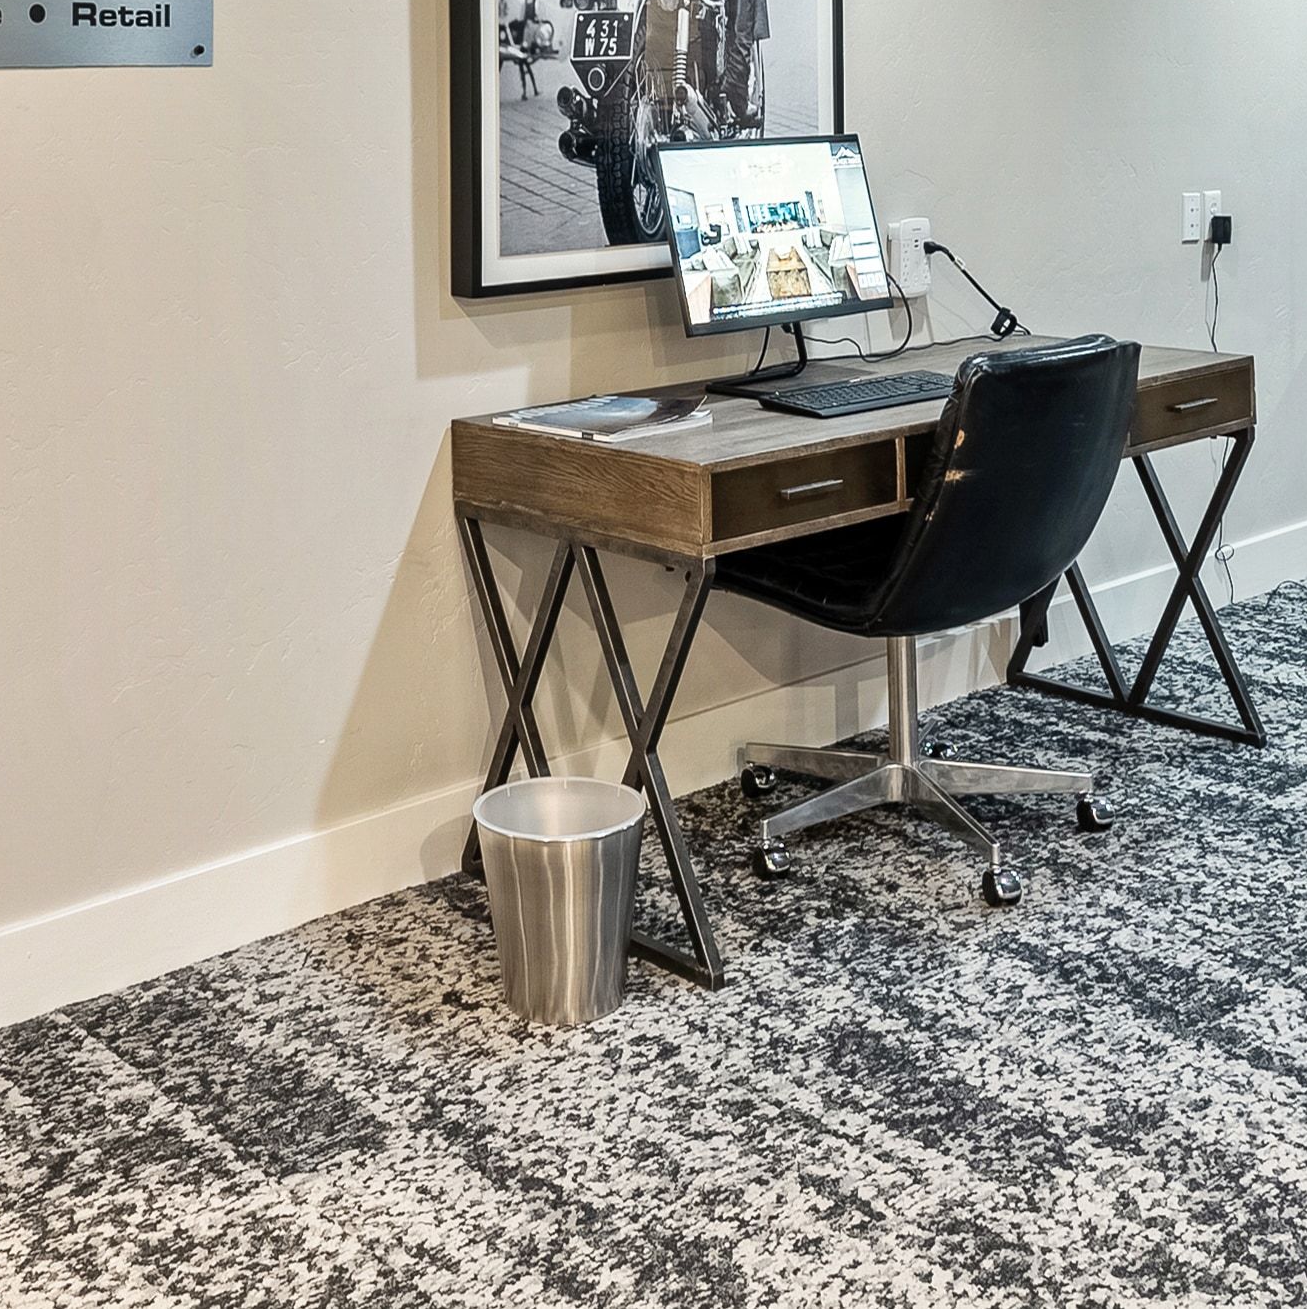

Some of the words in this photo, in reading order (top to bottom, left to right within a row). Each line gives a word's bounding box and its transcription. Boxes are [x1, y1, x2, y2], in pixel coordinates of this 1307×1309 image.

[71, 2, 172, 29] Retail
[586, 18, 619, 38] 431
[585, 38, 595, 56] W
[600, 38, 617, 55] 75
